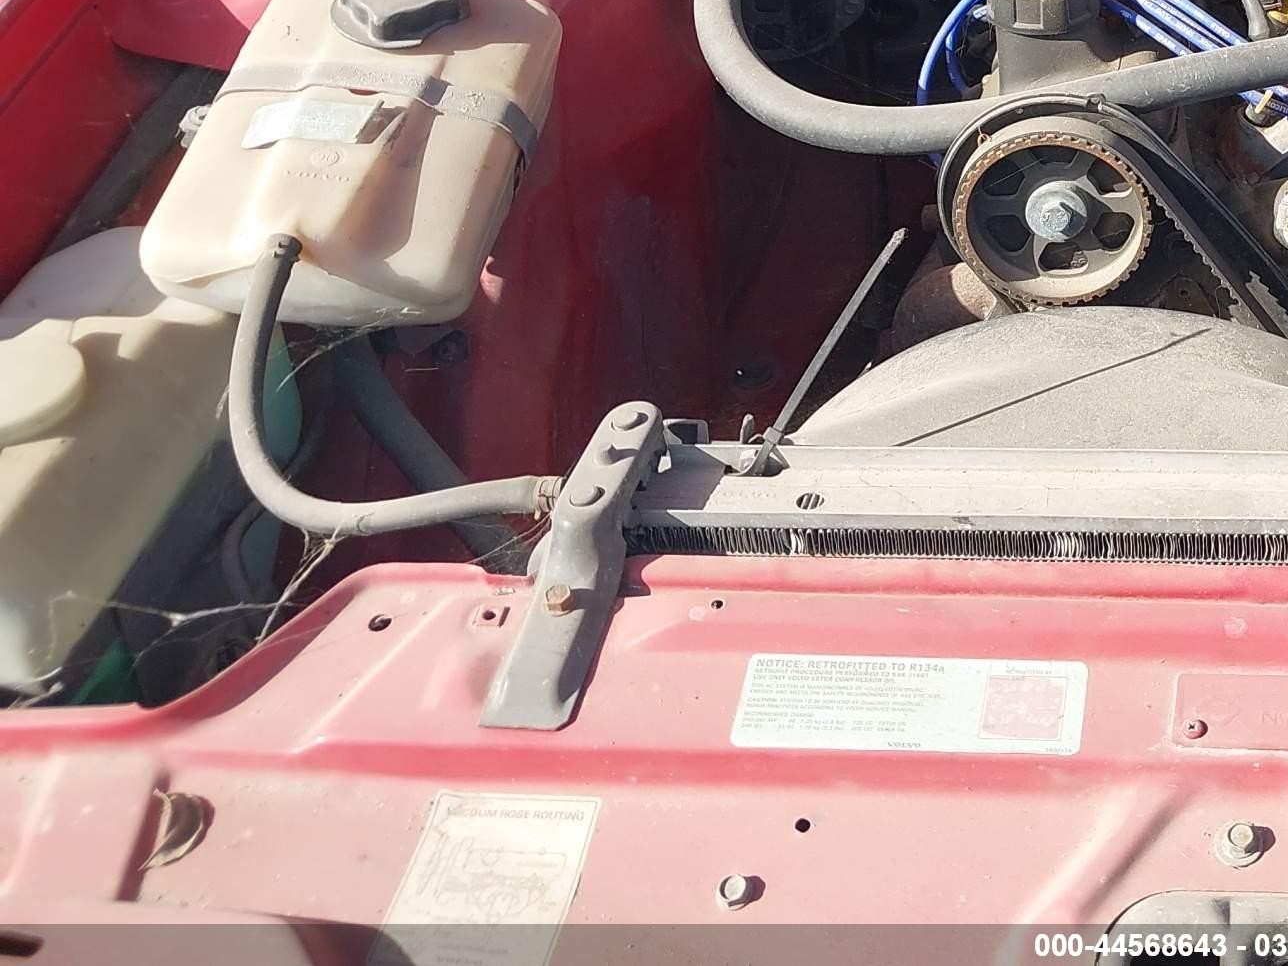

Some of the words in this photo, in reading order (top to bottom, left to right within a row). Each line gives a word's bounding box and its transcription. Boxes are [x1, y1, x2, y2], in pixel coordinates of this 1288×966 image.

[891, 663, 906, 671] TO
[909, 663, 945, 675] R134a
[499, 809, 530, 819] HOSE
[532, 809, 585, 822] ROUTING
